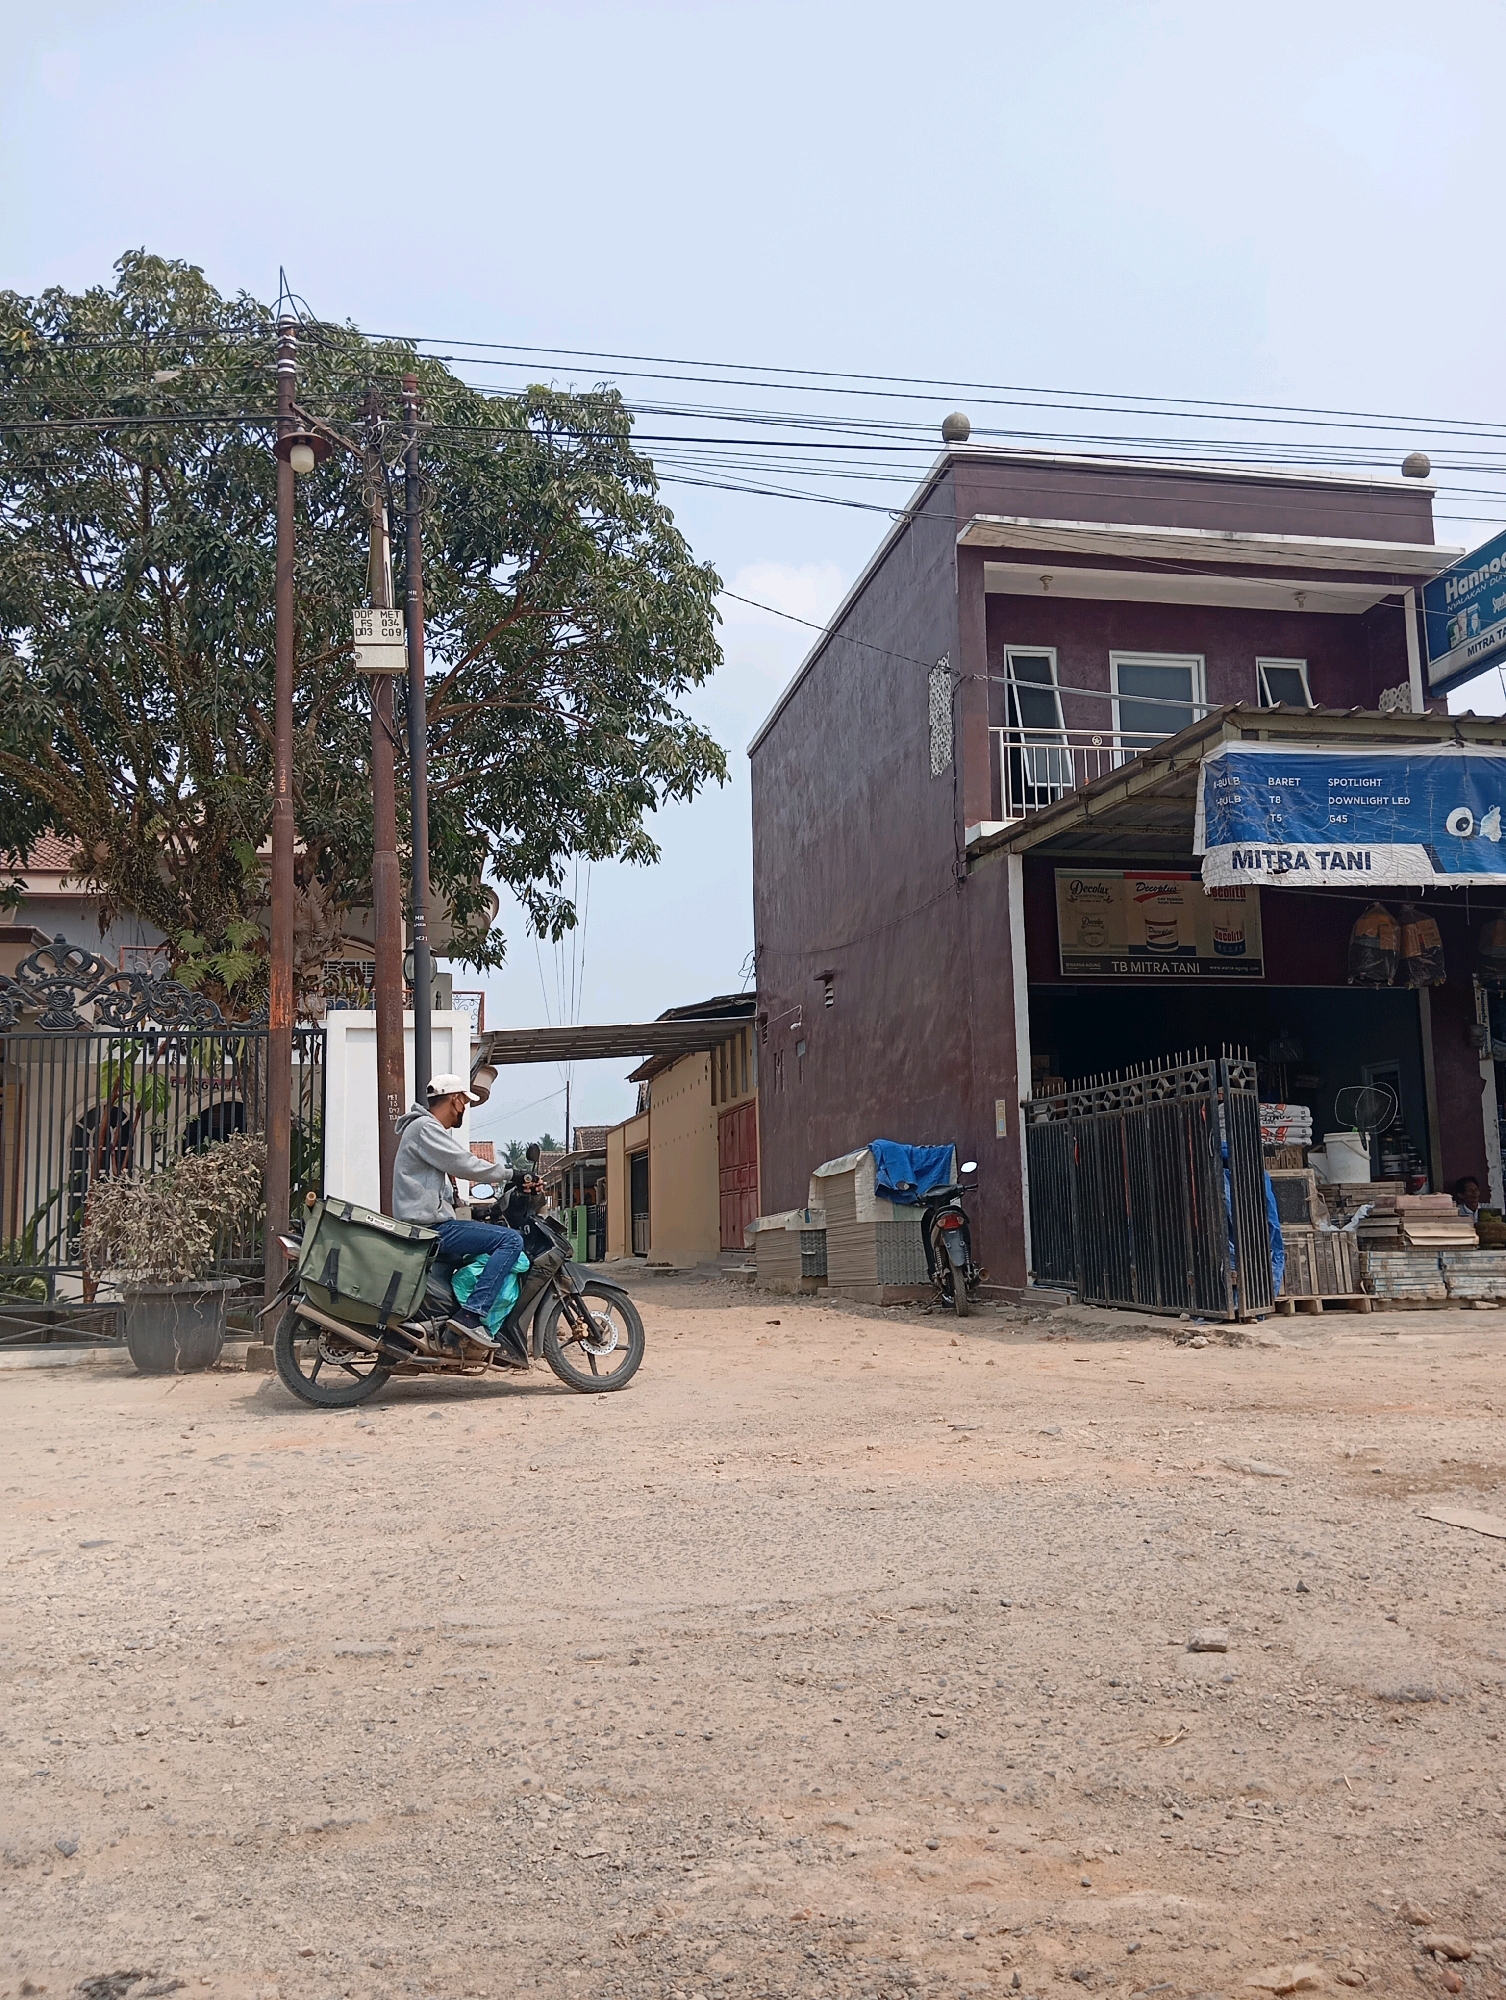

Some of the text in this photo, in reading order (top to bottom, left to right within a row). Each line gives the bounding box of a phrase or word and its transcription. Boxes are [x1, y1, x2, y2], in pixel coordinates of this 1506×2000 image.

[1447, 583, 1487, 613] NYALAKAN
[380, 610, 401, 618] MET
[1467, 634, 1496, 658] MITRA
[1268, 777, 1301, 787] BARET
[1327, 778, 1382, 787] SPOTLIGHT
[1269, 795, 1282, 804] T8
[1328, 796, 1411, 805] DOWNLIGHT LED
[1270, 813, 1283, 822] T5
[1329, 814, 1348, 823] G45
[1232, 849, 1372, 871] MITRA TANI
[1135, 881, 1178, 894] Decoplus
[1111, 961, 1200, 974] TB MITRA TANI
